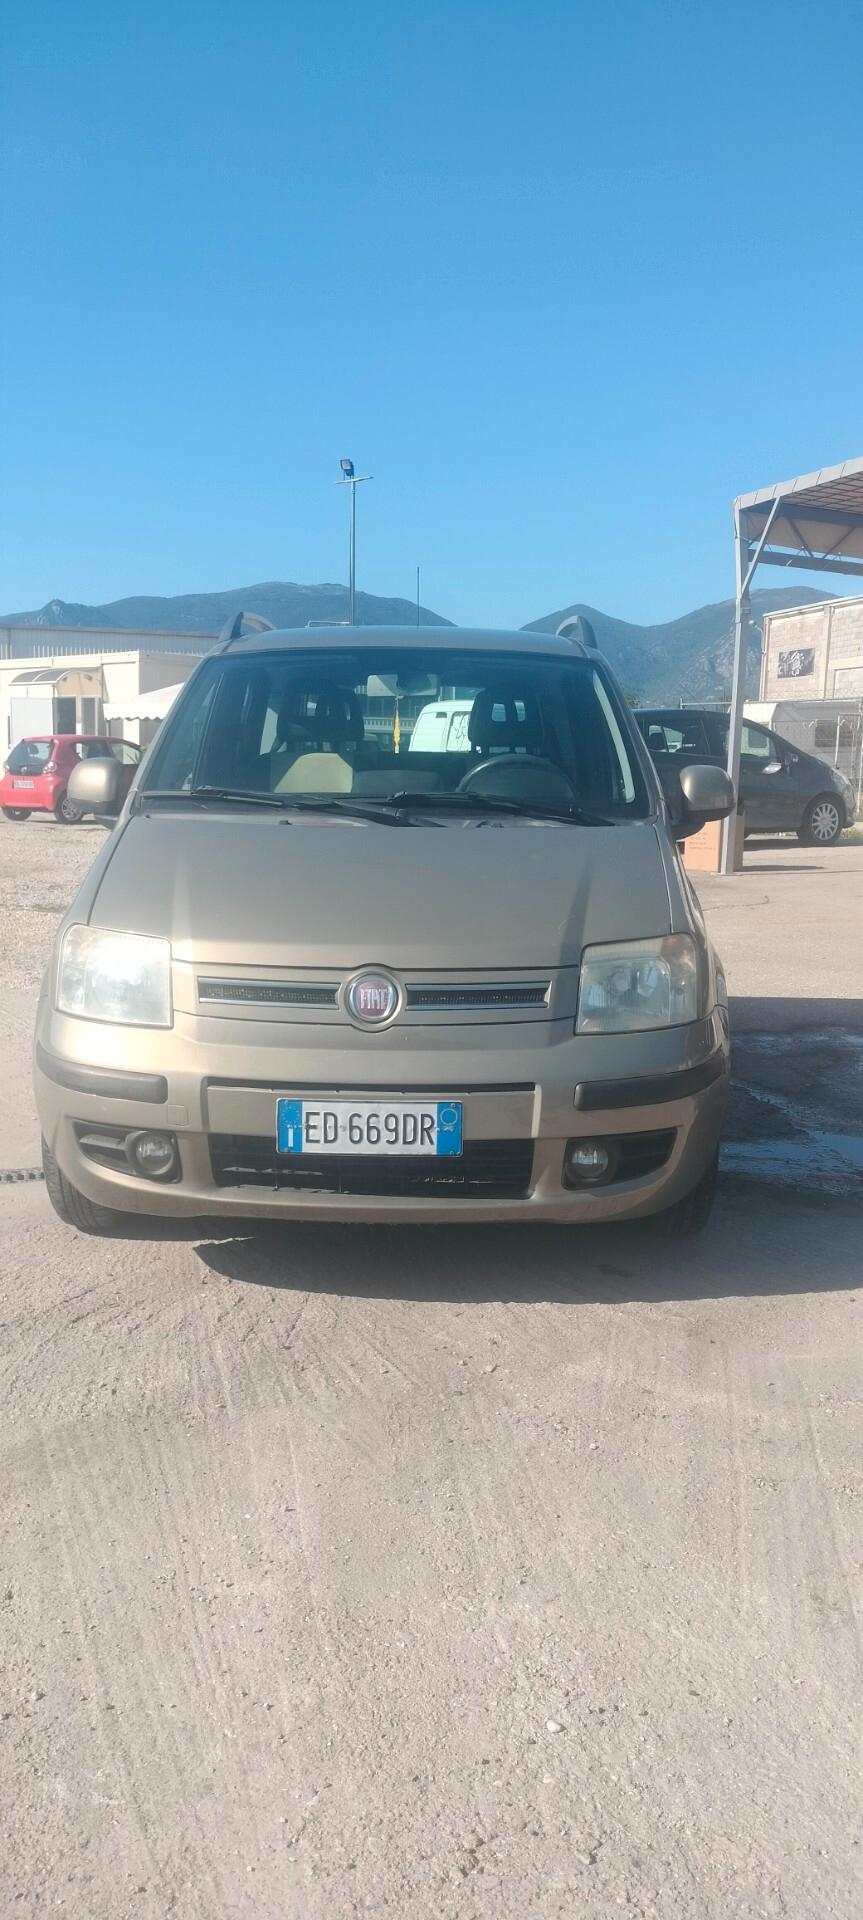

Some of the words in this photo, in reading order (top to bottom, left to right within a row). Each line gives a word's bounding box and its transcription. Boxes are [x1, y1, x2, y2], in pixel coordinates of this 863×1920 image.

[360, 988, 388, 1010] FIAT
[305, 1112, 338, 1144] ED
[349, 1112, 436, 1146] 669DR
